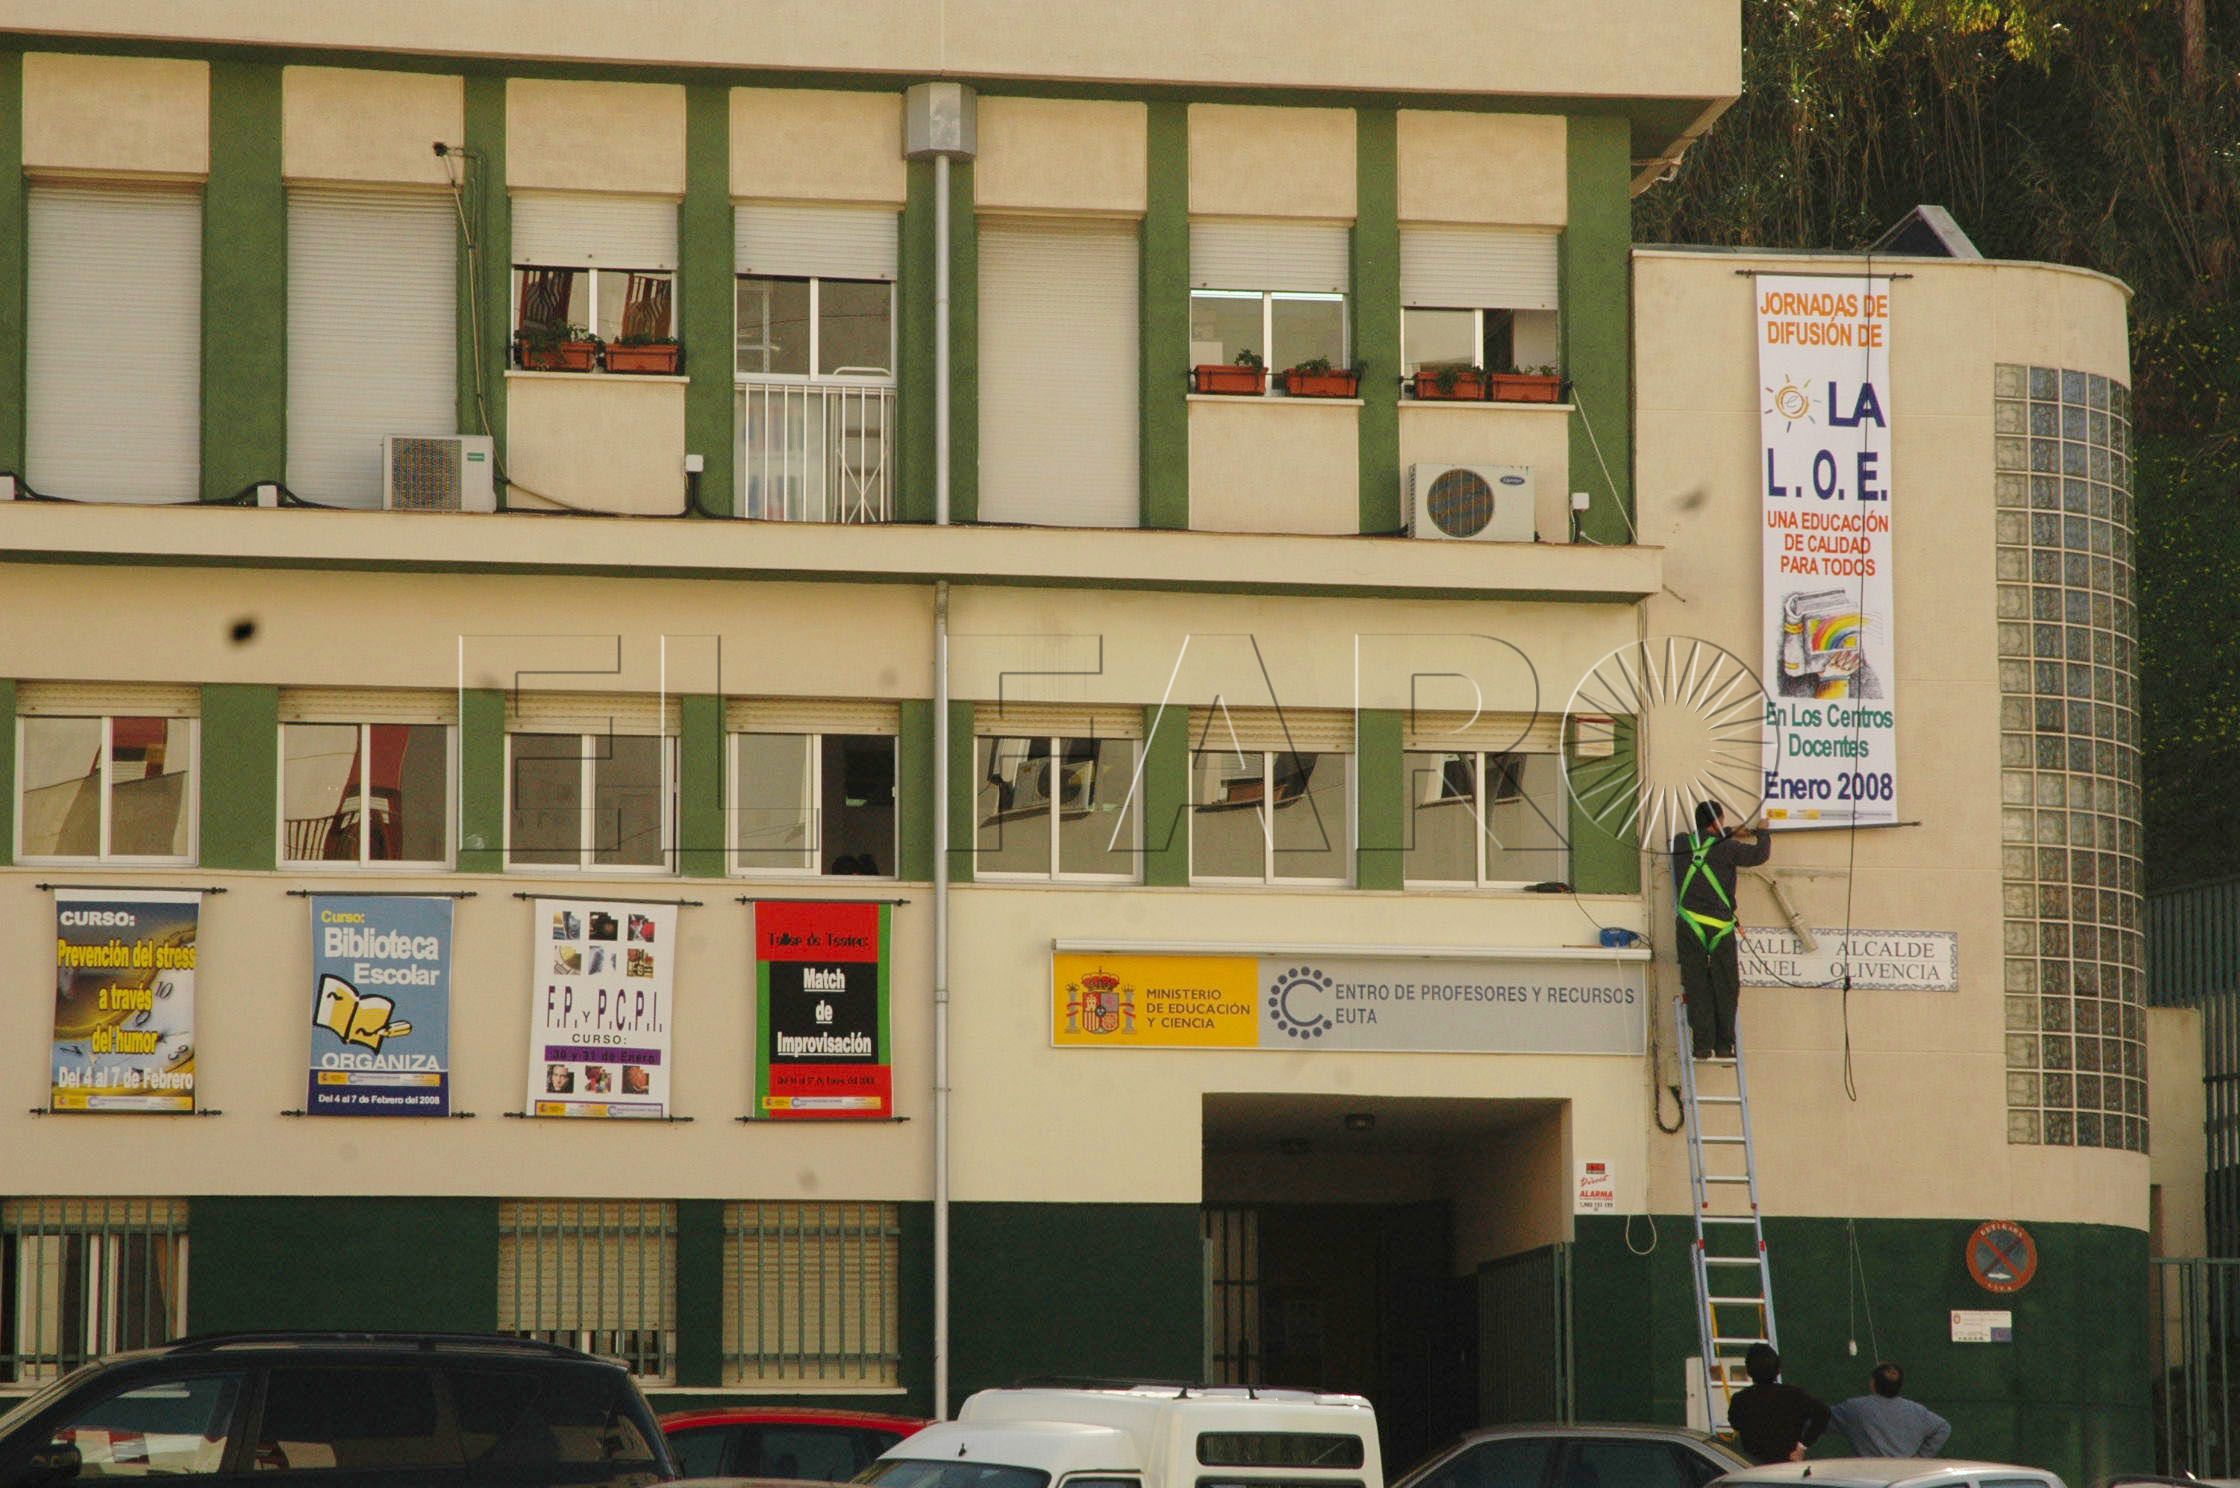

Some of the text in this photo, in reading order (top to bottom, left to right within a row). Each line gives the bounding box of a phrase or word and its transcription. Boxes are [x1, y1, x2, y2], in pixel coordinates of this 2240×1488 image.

[1760, 292, 1888, 318] JORNADAS DE
[1767, 317, 1883, 347] DIFUSIÓN DE
[1828, 381, 1887, 427] LA
[1767, 510, 1888, 532] UNA EDUCACIÓN
[1784, 533, 1871, 554] DE CALIDAD
[1780, 556, 1876, 576] PARA TODOS
[1766, 702, 1893, 728] En Los Centros
[1789, 733, 1869, 758] Docentes
[1765, 771, 1893, 801] Enero 2008
[60, 911, 135, 926] CURSO:
[321, 910, 365, 923] Curso:
[58, 938, 196, 969] Prevención del stress
[325, 927, 439, 960] Biblioteca
[1739, 939, 1936, 958] CALLE ALCALDE
[354, 962, 440, 985] Escolar
[803, 967, 845, 991] Match
[1739, 960, 1941, 980] ANUEL OLIVENCIA
[99, 982, 152, 1010] a través
[1146, 989, 1222, 1000] MINISTERIO
[1395, 985, 1415, 1000] DE
[1421, 985, 1527, 1002] PROFESORES
[1532, 987, 1541, 1003] Y
[1547, 987, 1635, 1004] RECURSOS
[582, 1010, 590, 1023] Y
[815, 1000, 833, 1023] de
[1147, 1003, 1250, 1015] DE EDUCACIÓN
[1147, 1017, 1215, 1028] Y CIENCIA
[92, 1025, 158, 1054] del humor
[572, 1033, 627, 1045] CURSO:
[777, 1031, 871, 1057] Improvisación
[321, 1052, 440, 1070] ORGANIZA
[59, 1066, 193, 1089] Del 4 al 7 de Febrero
[318, 1094, 440, 1105] Del 4 al 7 de Febrero del 2008
[1580, 1190, 1613, 1198] ALARMA
